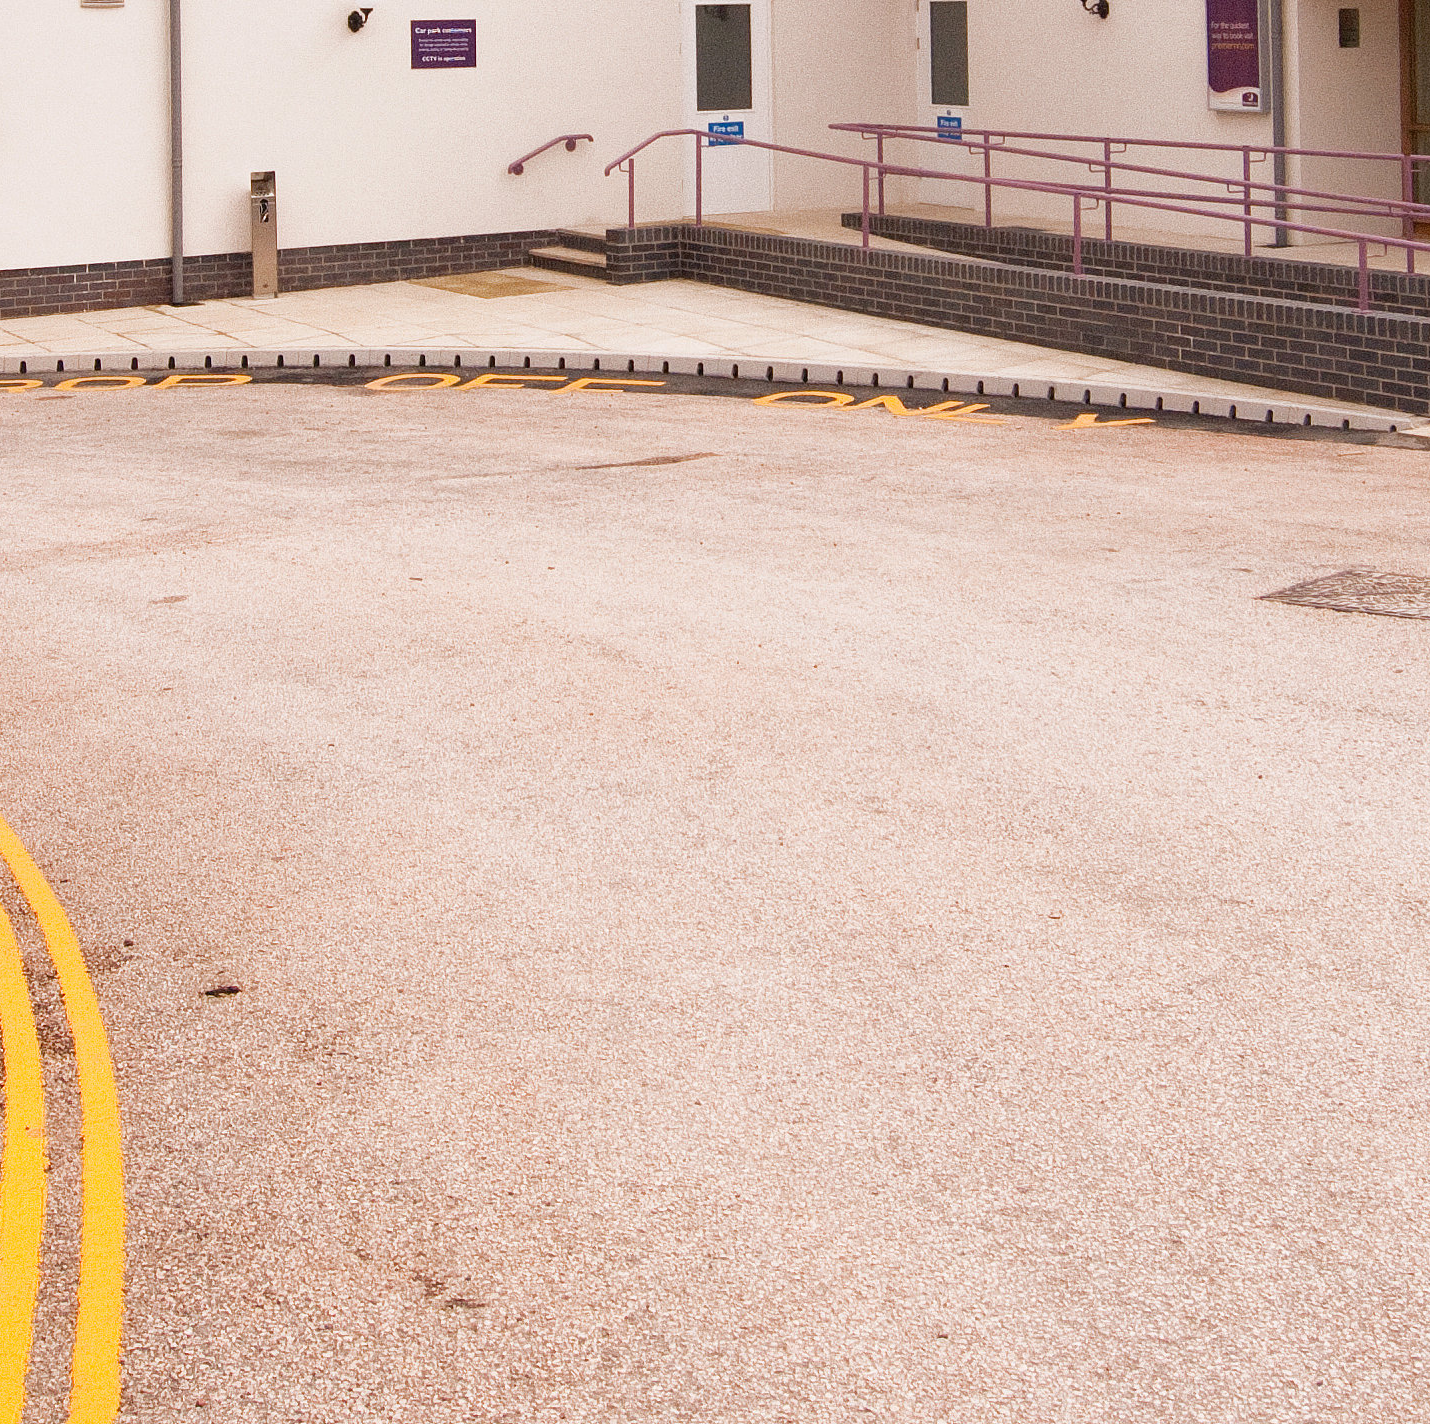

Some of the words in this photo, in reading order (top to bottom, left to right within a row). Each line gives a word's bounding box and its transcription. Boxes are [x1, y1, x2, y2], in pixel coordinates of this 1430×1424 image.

[427, 27, 441, 36] park
[713, 125, 726, 134] Fire
[364, 372, 666, 395] OFF
[751, 390, 1155, 431] ONLY
